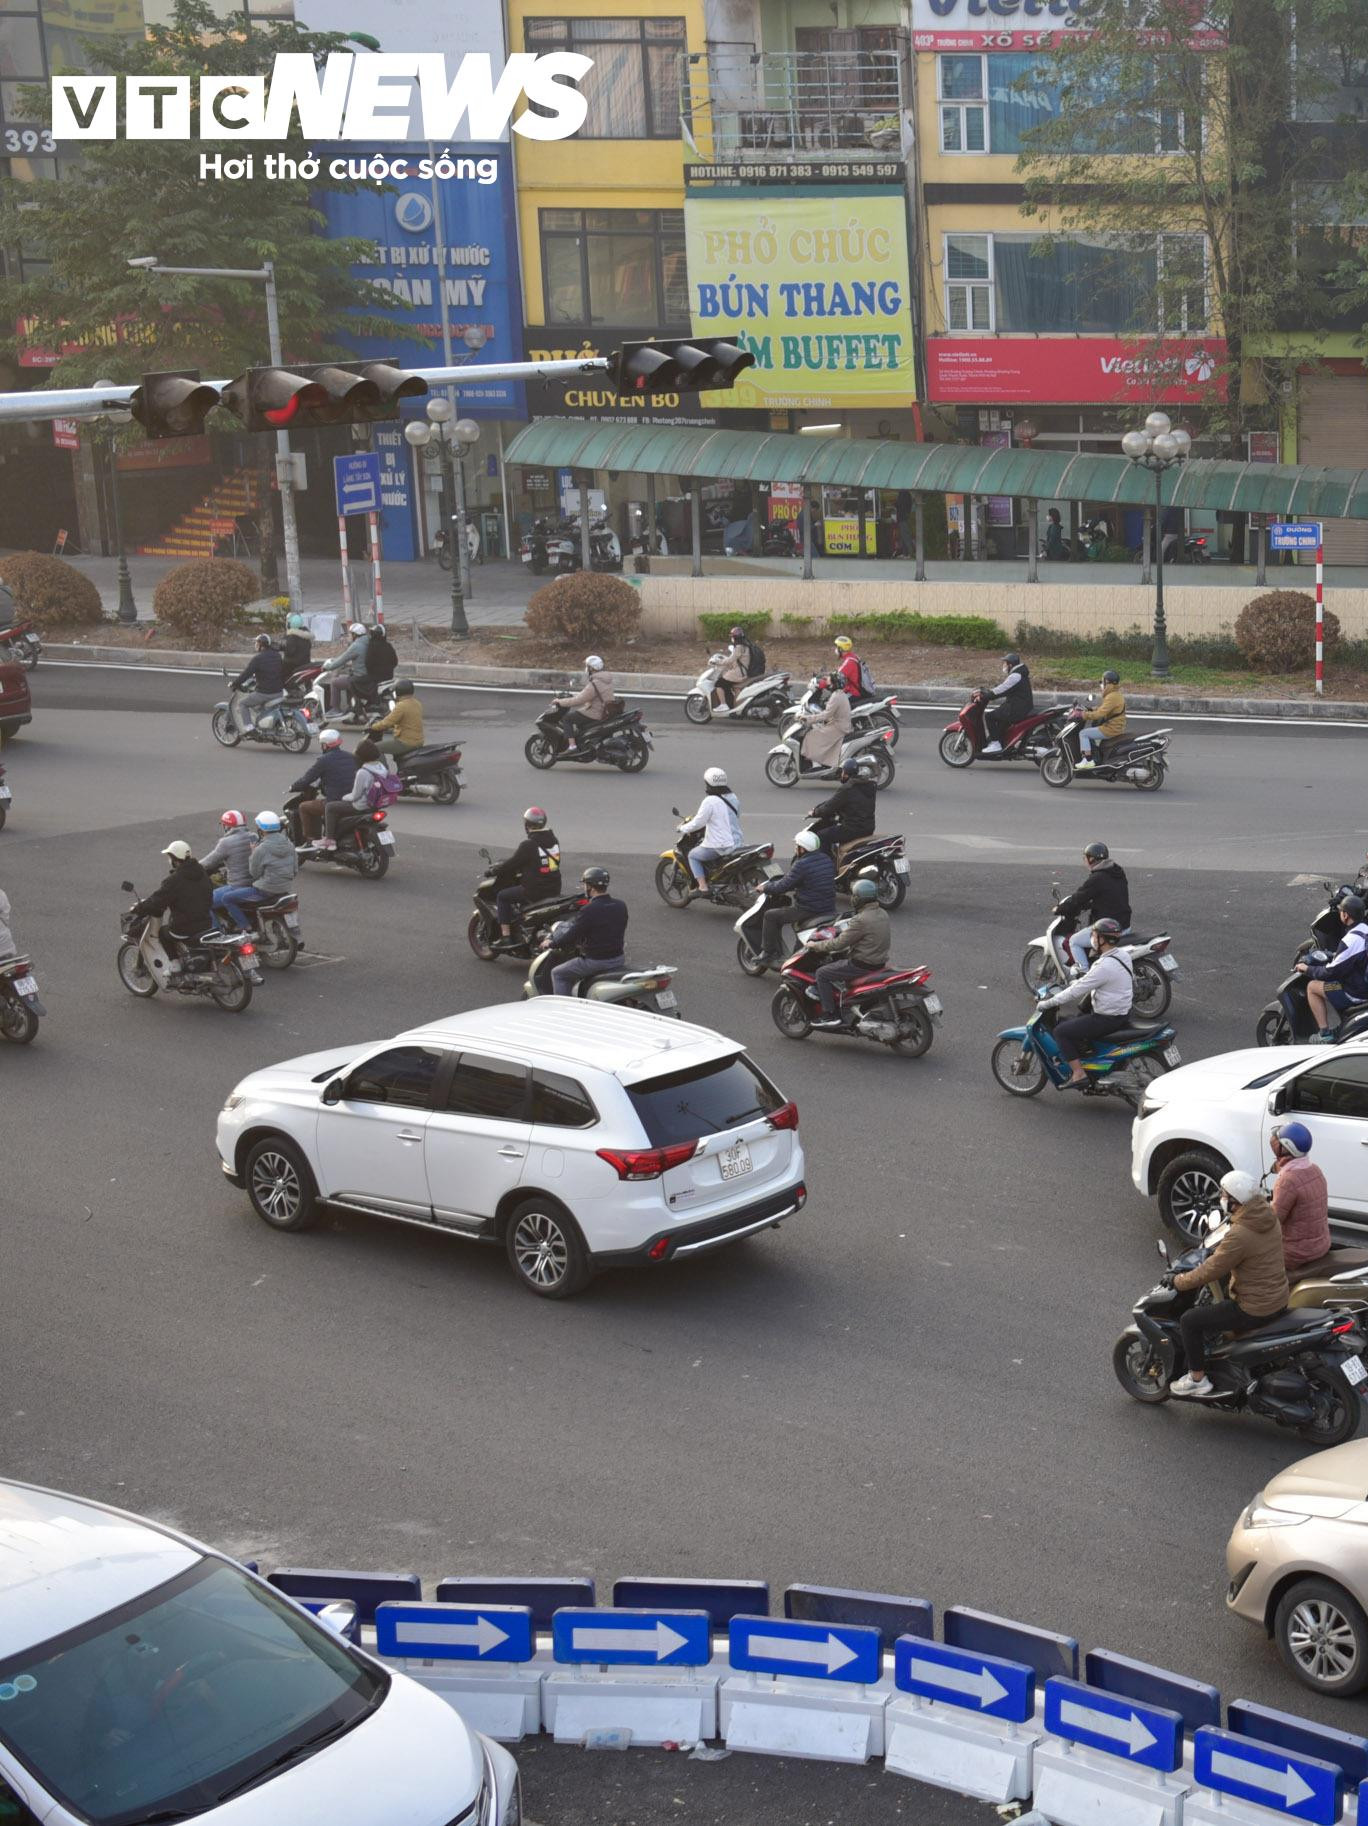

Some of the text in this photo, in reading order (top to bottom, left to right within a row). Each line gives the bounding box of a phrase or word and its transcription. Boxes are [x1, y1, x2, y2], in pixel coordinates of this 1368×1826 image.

[5, 129, 57, 152] 393
[690, 166, 737, 178] HOTLINE:
[739, 166, 767, 177] 0916
[769, 166, 788, 177] 871
[790, 166, 812, 177] 383
[822, 165, 849, 176] 0913
[852, 165, 874, 176] 549
[877, 165, 898, 176] 597
[703, 216, 891, 265] PHỞ CHÚC
[451, 243, 490, 266] NƯỚC
[697, 273, 902, 318] BÚN THANG
[780, 333, 902, 370] BUFFET
[722, 1159, 752, 1180] 580.09
